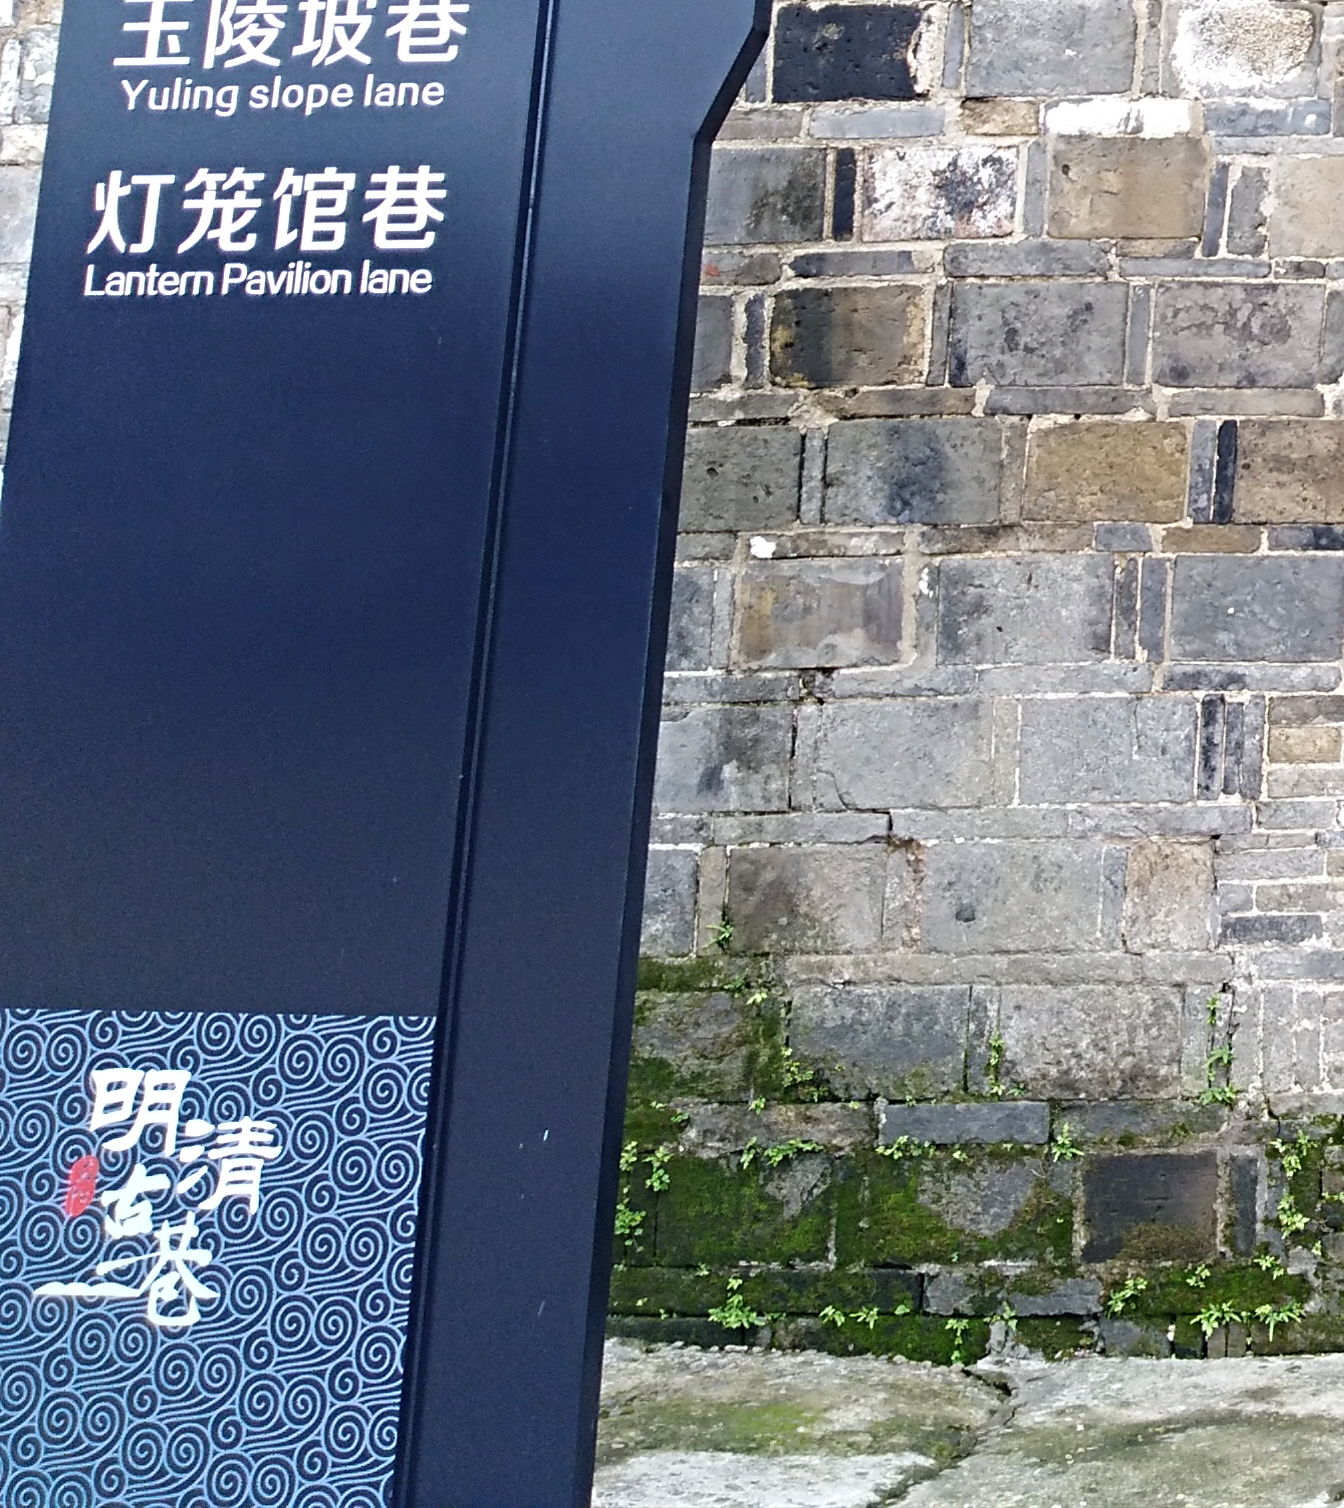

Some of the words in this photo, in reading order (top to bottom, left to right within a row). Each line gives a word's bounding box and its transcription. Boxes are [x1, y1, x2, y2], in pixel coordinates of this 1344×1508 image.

[121, 77, 240, 118] Yuling
[248, 75, 354, 117] slope
[363, 73, 446, 109] lane
[86, 164, 448, 255] 灯笼馆巷
[83, 263, 216, 297] Lantern
[221, 260, 353, 297] Pavilion
[360, 259, 433, 294] lane
